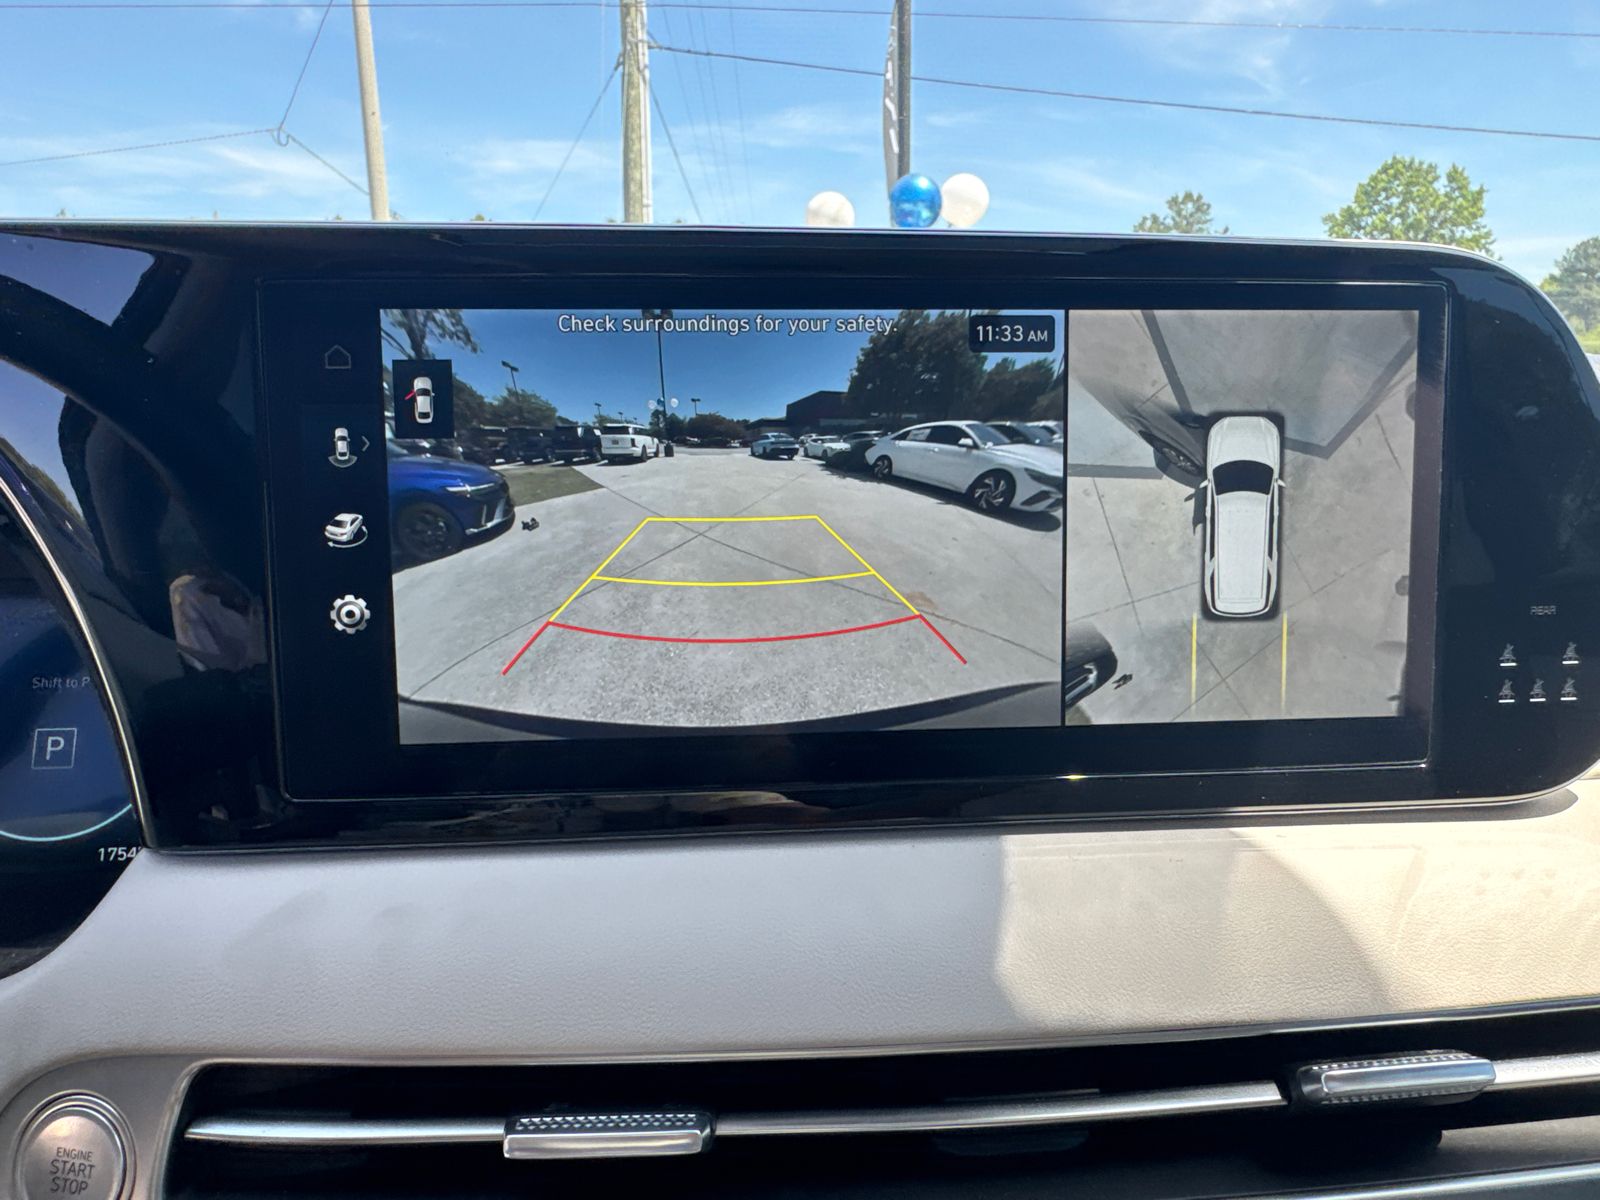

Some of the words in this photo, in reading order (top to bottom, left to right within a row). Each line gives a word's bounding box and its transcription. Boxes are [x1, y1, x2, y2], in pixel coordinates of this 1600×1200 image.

[558, 314, 617, 332] Check
[622, 314, 750, 336] surroundings
[756, 314, 783, 332] for
[788, 317, 830, 336] your
[836, 314, 898, 336] safety.
[976, 324, 1024, 342] 11:33
[1027, 329, 1048, 342] AM
[1530, 605, 1557, 616] REAR
[32, 676, 62, 689] Shift
[66, 678, 79, 689] to
[45, 735, 65, 761] P
[98, 846, 142, 862] 1754
[56, 1146, 93, 1161] ENGINE
[49, 1159, 96, 1179] START
[50, 1176, 89, 1195] STOP
